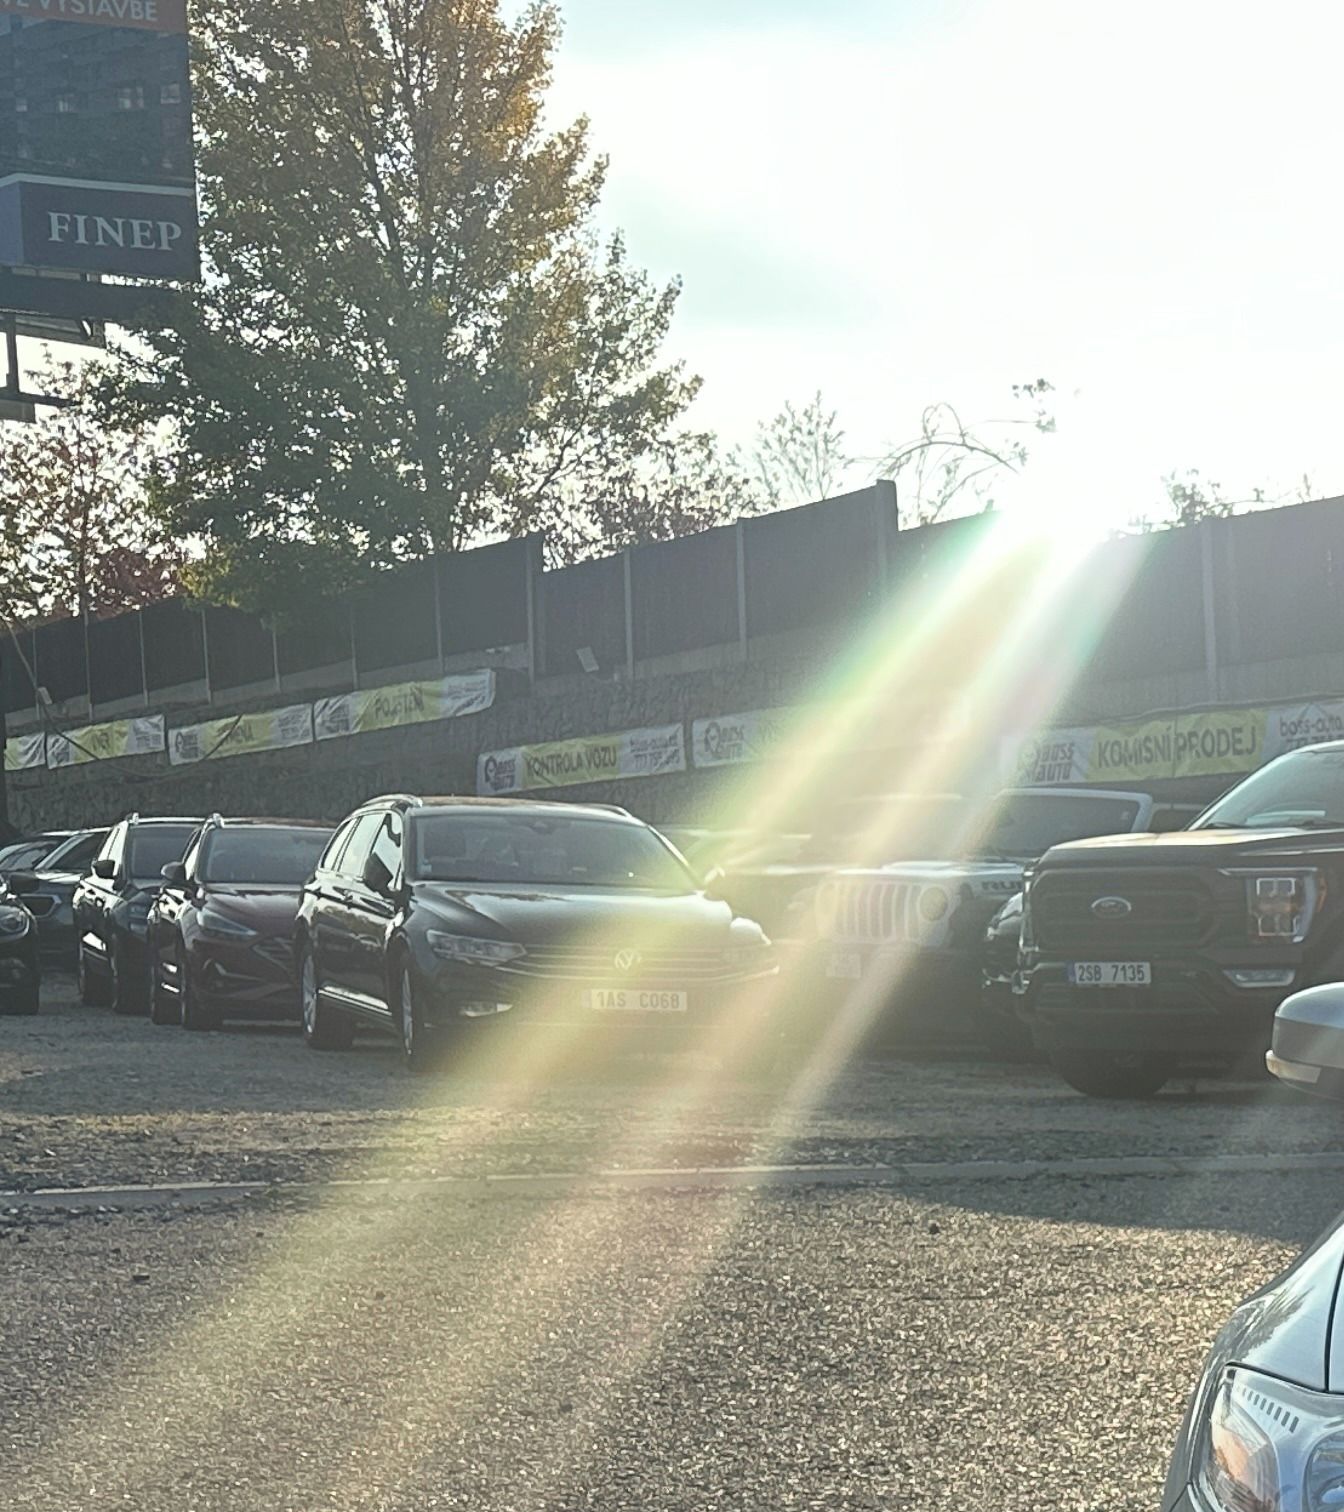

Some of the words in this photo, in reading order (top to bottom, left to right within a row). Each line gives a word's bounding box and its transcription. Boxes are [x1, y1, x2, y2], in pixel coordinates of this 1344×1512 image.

[47, 211, 182, 252] FINEP
[525, 754, 583, 777] KONTROLA
[586, 746, 617, 769] VOZU
[1098, 726, 1173, 769] KOMISNÍ
[1175, 726, 1257, 762] PRODEJ
[1077, 964, 1102, 982] 2SB
[1111, 964, 1145, 982] 7135
